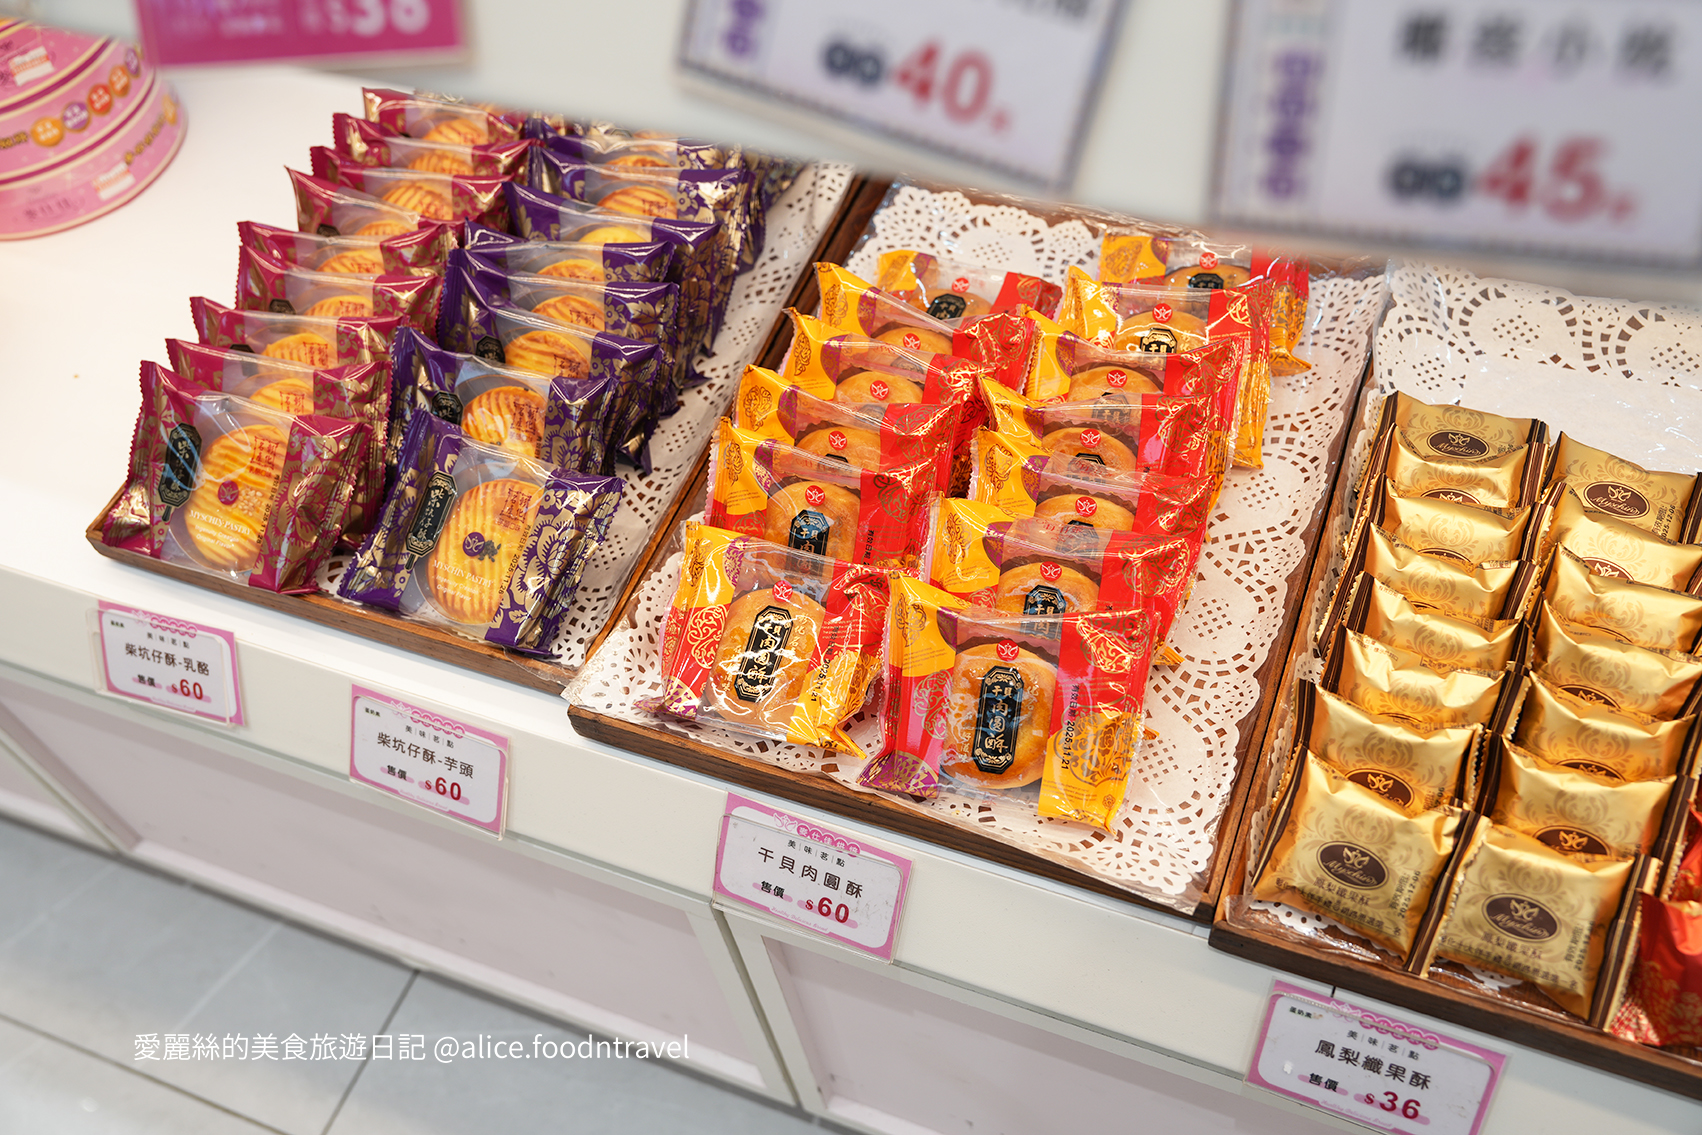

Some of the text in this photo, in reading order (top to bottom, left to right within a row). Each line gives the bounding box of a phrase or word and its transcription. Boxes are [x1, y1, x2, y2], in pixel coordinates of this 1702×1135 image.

[1660, 504, 1676, 538] 025-12-06
[125, 642, 210, 676] 柴坑仔酥-乳酪
[171, 678, 204, 700] $60
[377, 732, 474, 779] 柴坑仔酥-芋頭
[1061, 720, 1076, 770] 2025.11.21
[386, 765, 462, 801] 售價 $60
[758, 847, 863, 899] 干貝肉圓酥
[760, 880, 850, 924] 售價 $60
[1308, 1072, 1422, 1120] 售價 $36
